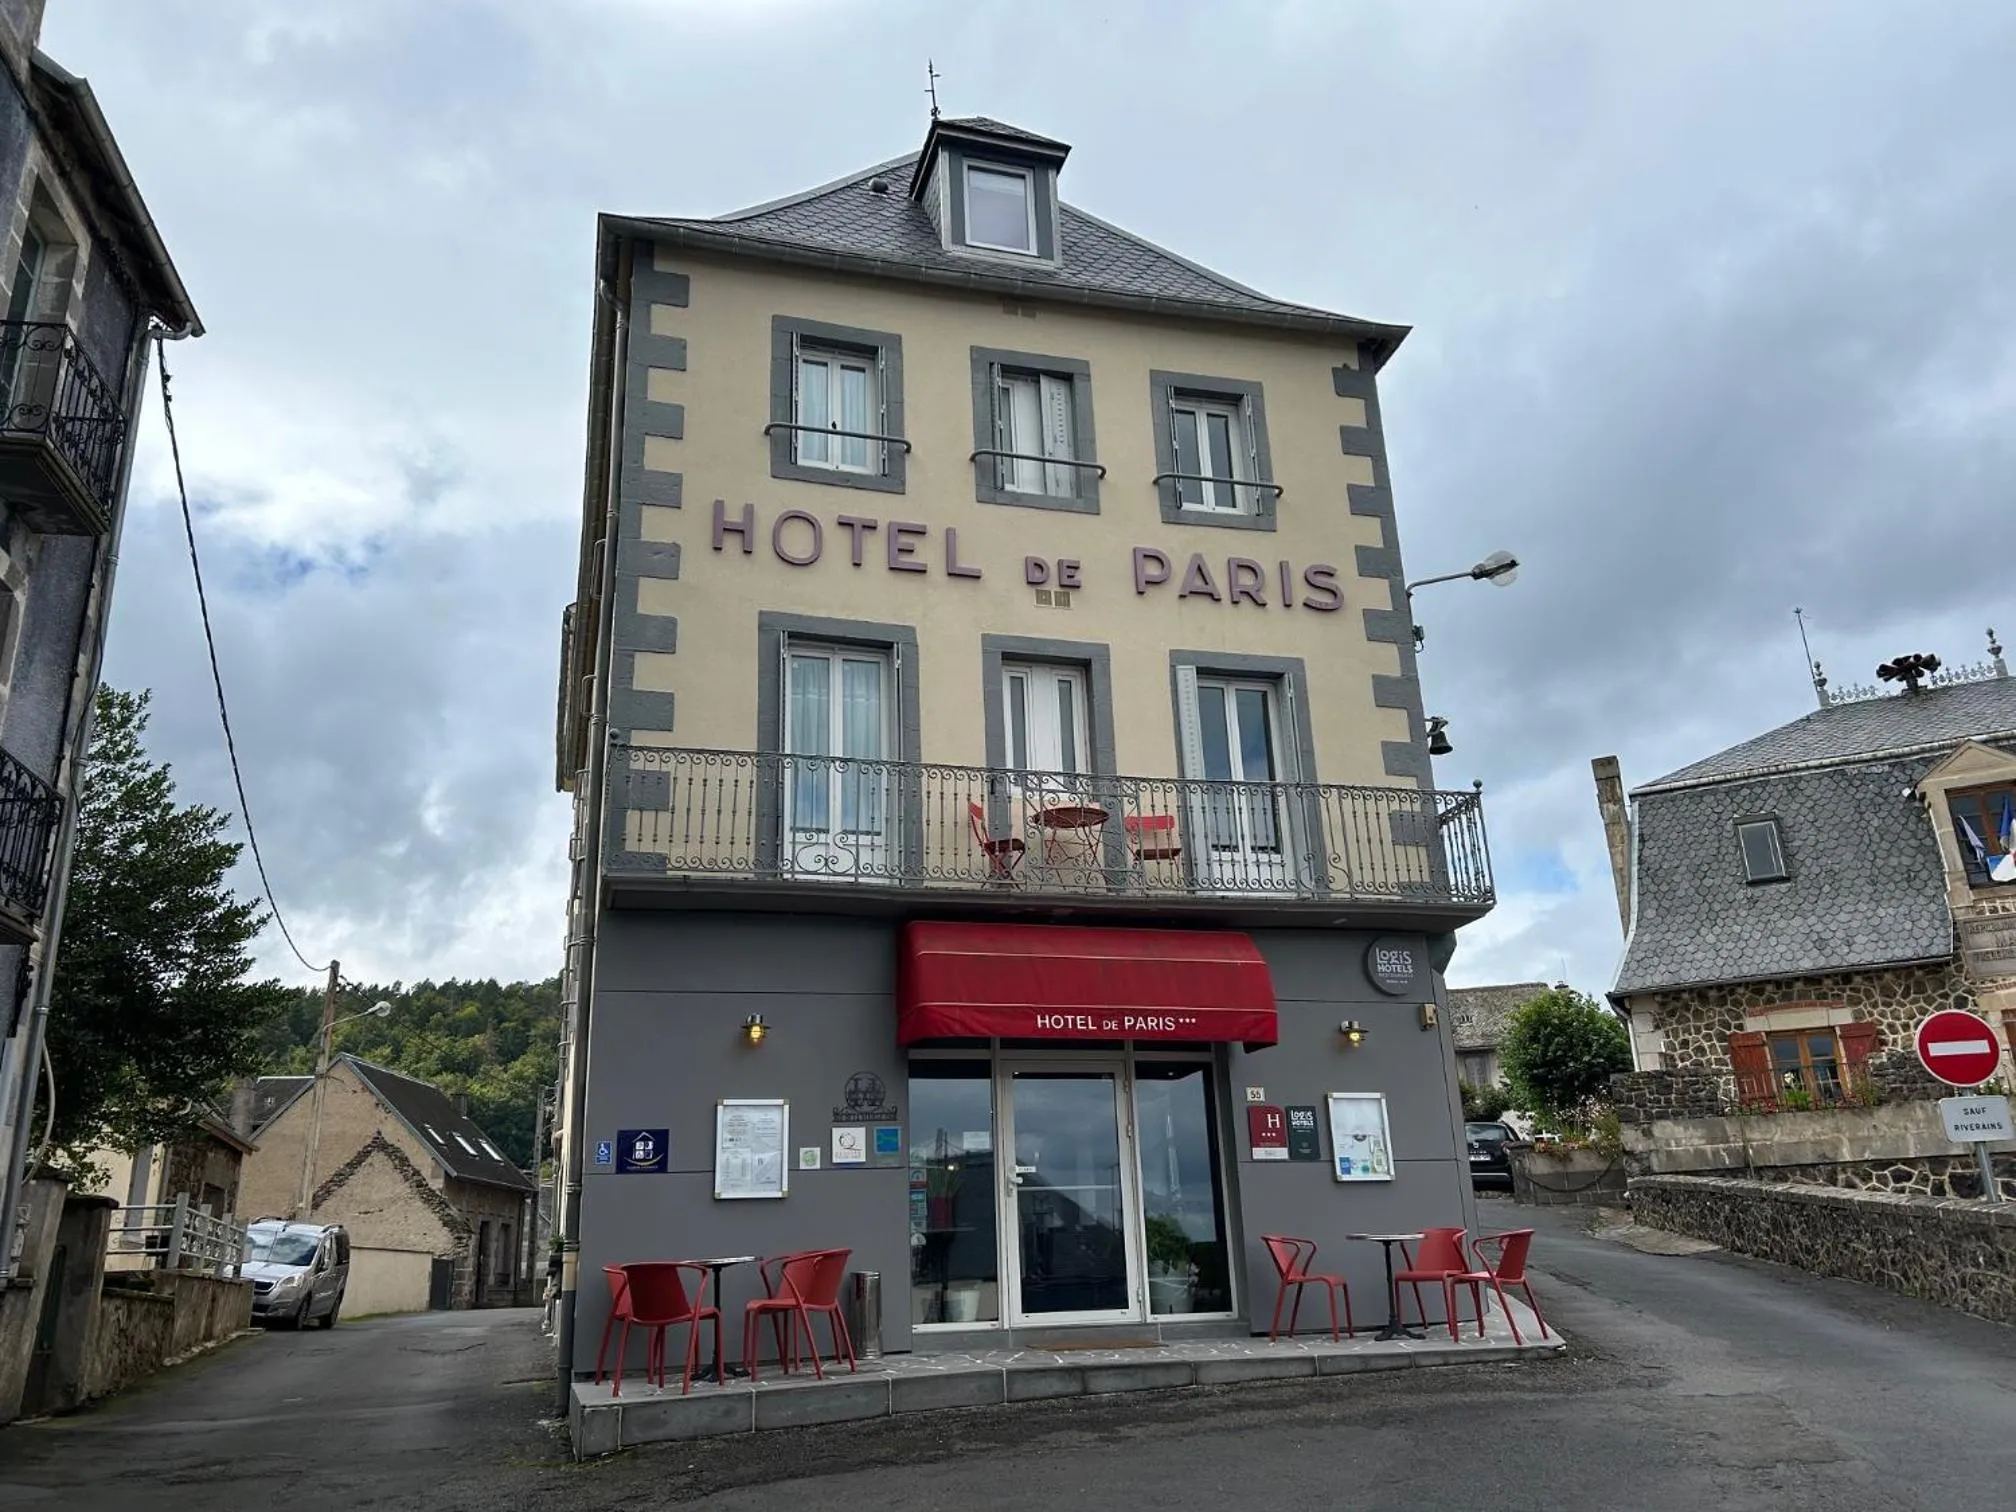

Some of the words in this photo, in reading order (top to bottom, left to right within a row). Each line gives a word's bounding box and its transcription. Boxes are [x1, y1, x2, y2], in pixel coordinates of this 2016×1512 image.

[712, 499, 982, 579] HOTEL
[1025, 555, 1081, 588] DE
[1132, 546, 1345, 611] PARIS
[1376, 964, 1413, 973] HOTELS
[1036, 1014, 1098, 1030] HOTEL
[1102, 1019, 1119, 1031] DE
[1124, 1015, 1176, 1031] PARIS
[1962, 1106, 1987, 1116] SAUF
[1266, 1113, 1281, 1129] H
[1953, 1122, 2004, 1132] RIVERAINS
